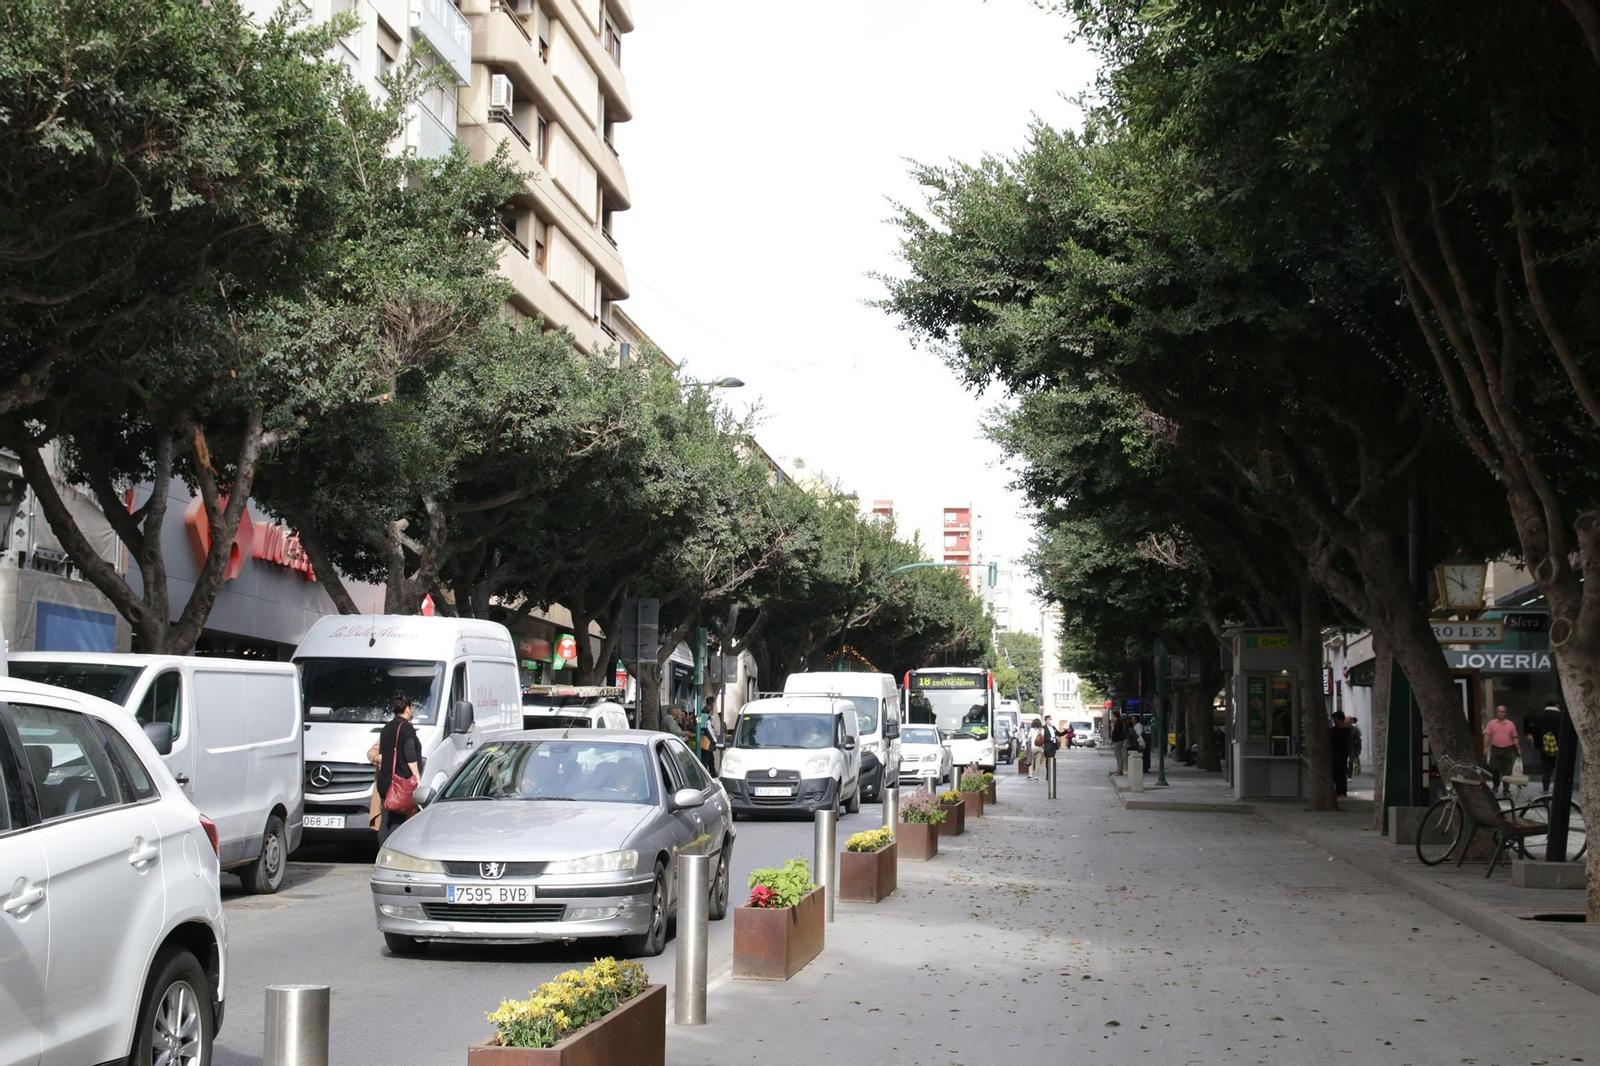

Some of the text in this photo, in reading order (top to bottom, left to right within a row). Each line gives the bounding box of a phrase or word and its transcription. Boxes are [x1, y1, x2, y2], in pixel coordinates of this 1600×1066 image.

[1455, 652, 1551, 669] JOYERÍA
[919, 677, 931, 686] 18
[303, 816, 343, 827] 068 JFT
[456, 887, 527, 902] 7595 BVB
